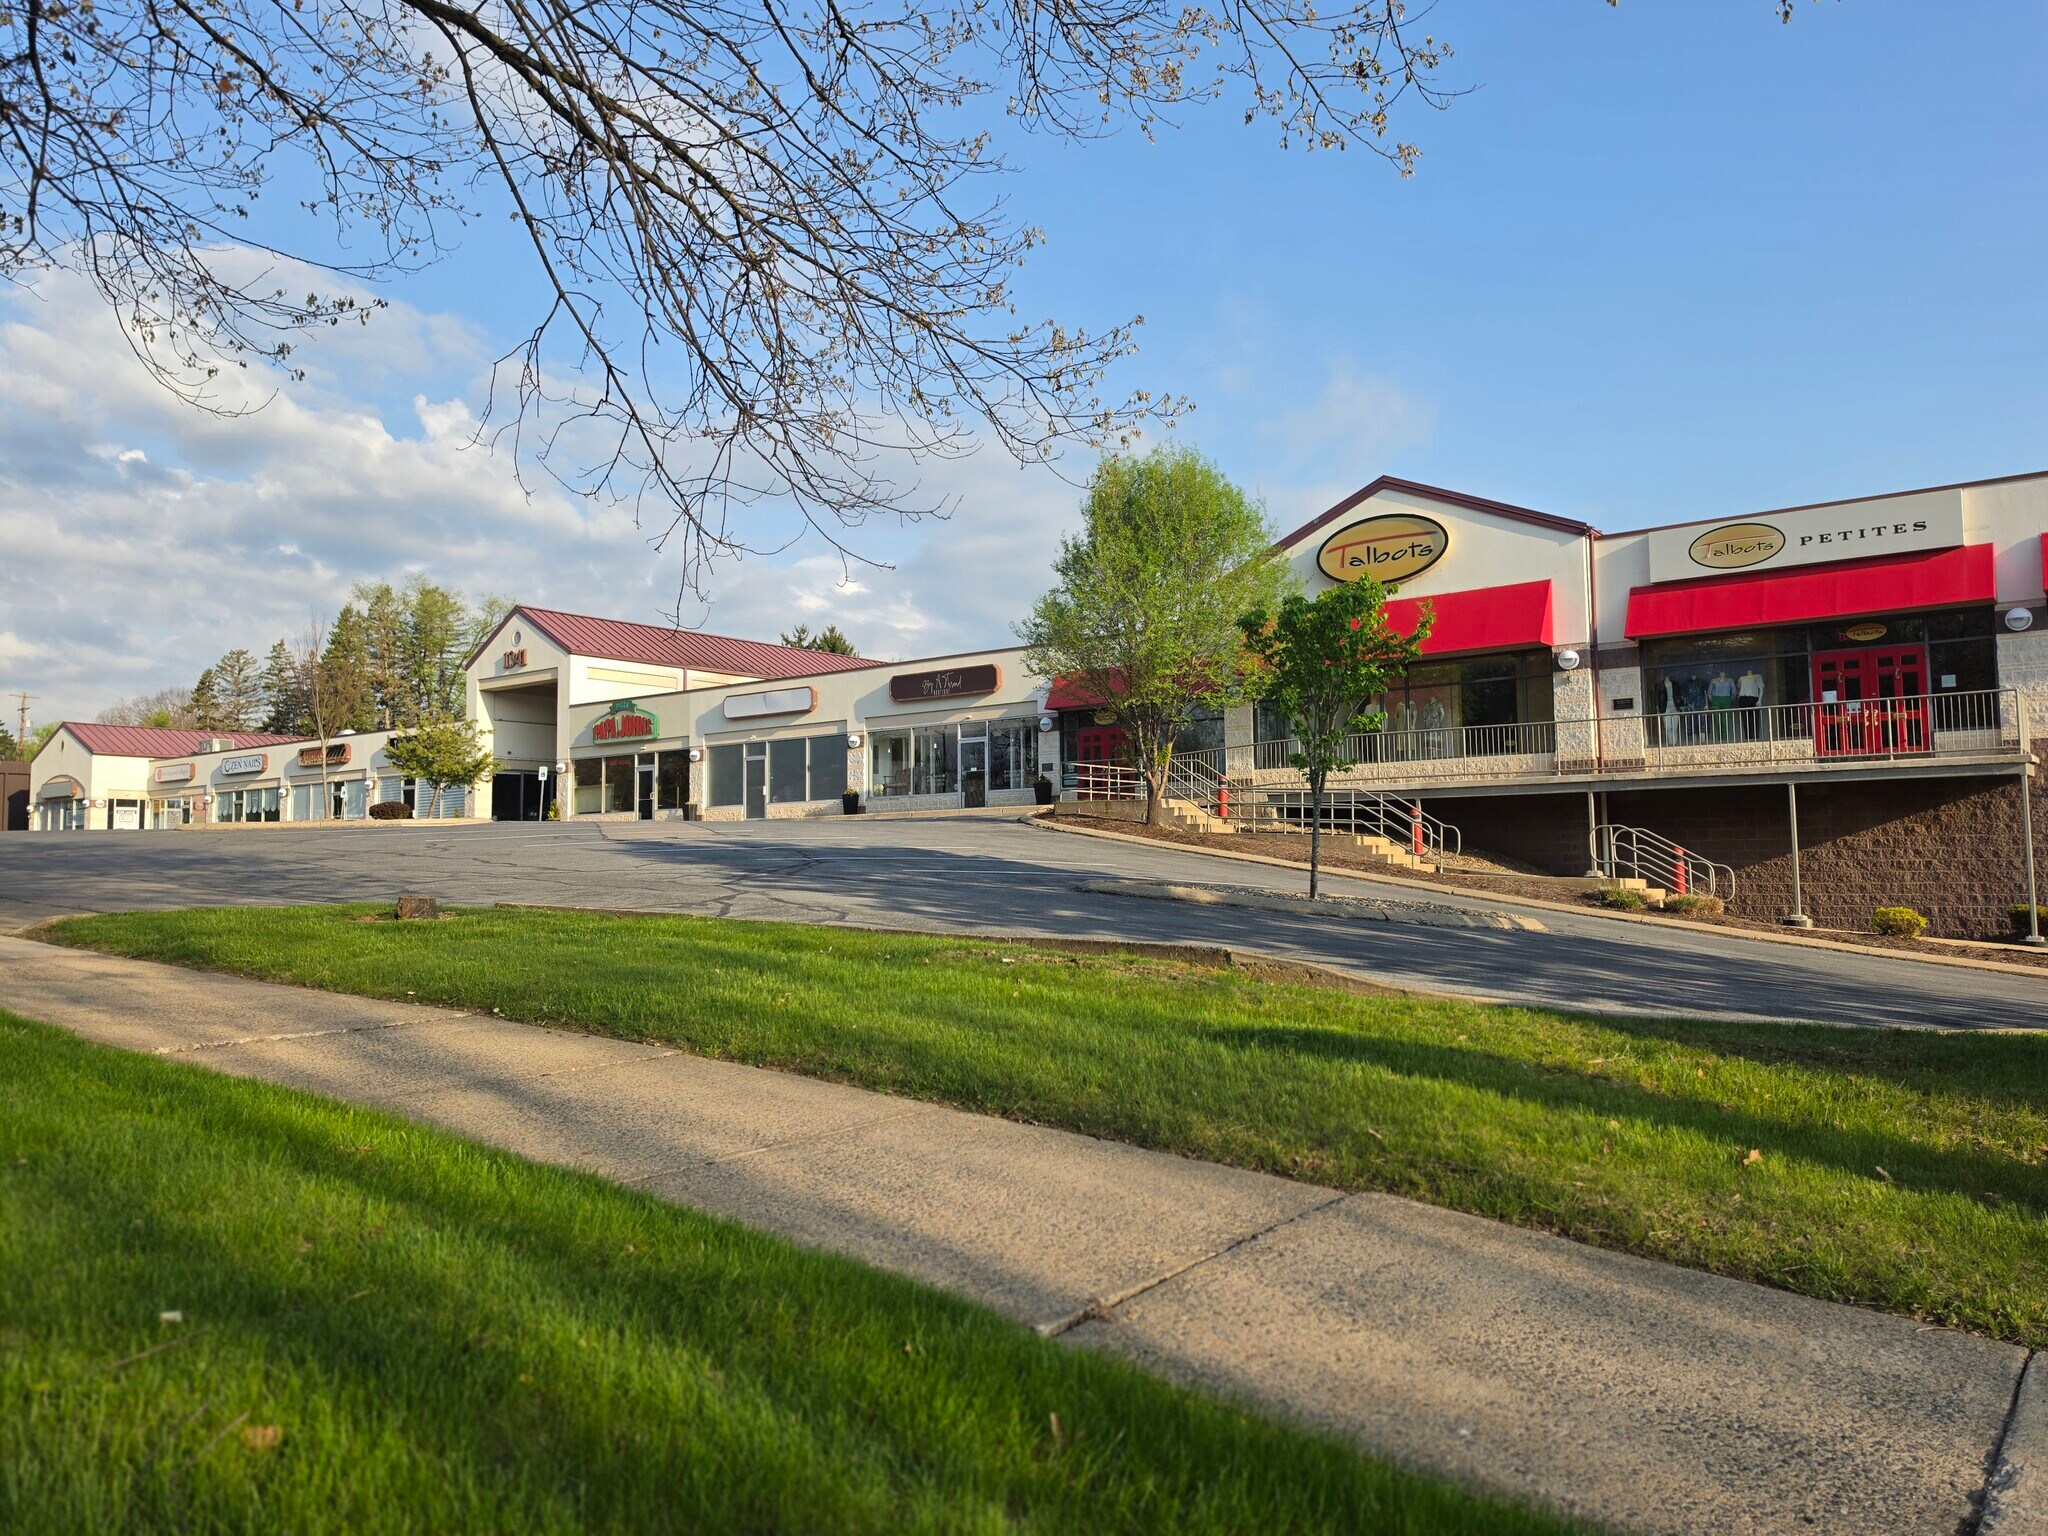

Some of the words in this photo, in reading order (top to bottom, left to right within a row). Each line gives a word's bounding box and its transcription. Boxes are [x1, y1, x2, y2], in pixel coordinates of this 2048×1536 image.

[1325, 530, 1438, 569] Talbots
[1695, 533, 1776, 559] Talbots
[1799, 520, 1928, 546] PETITES
[615, 701, 630, 709] PIZZA
[594, 716, 617, 740] PAPA
